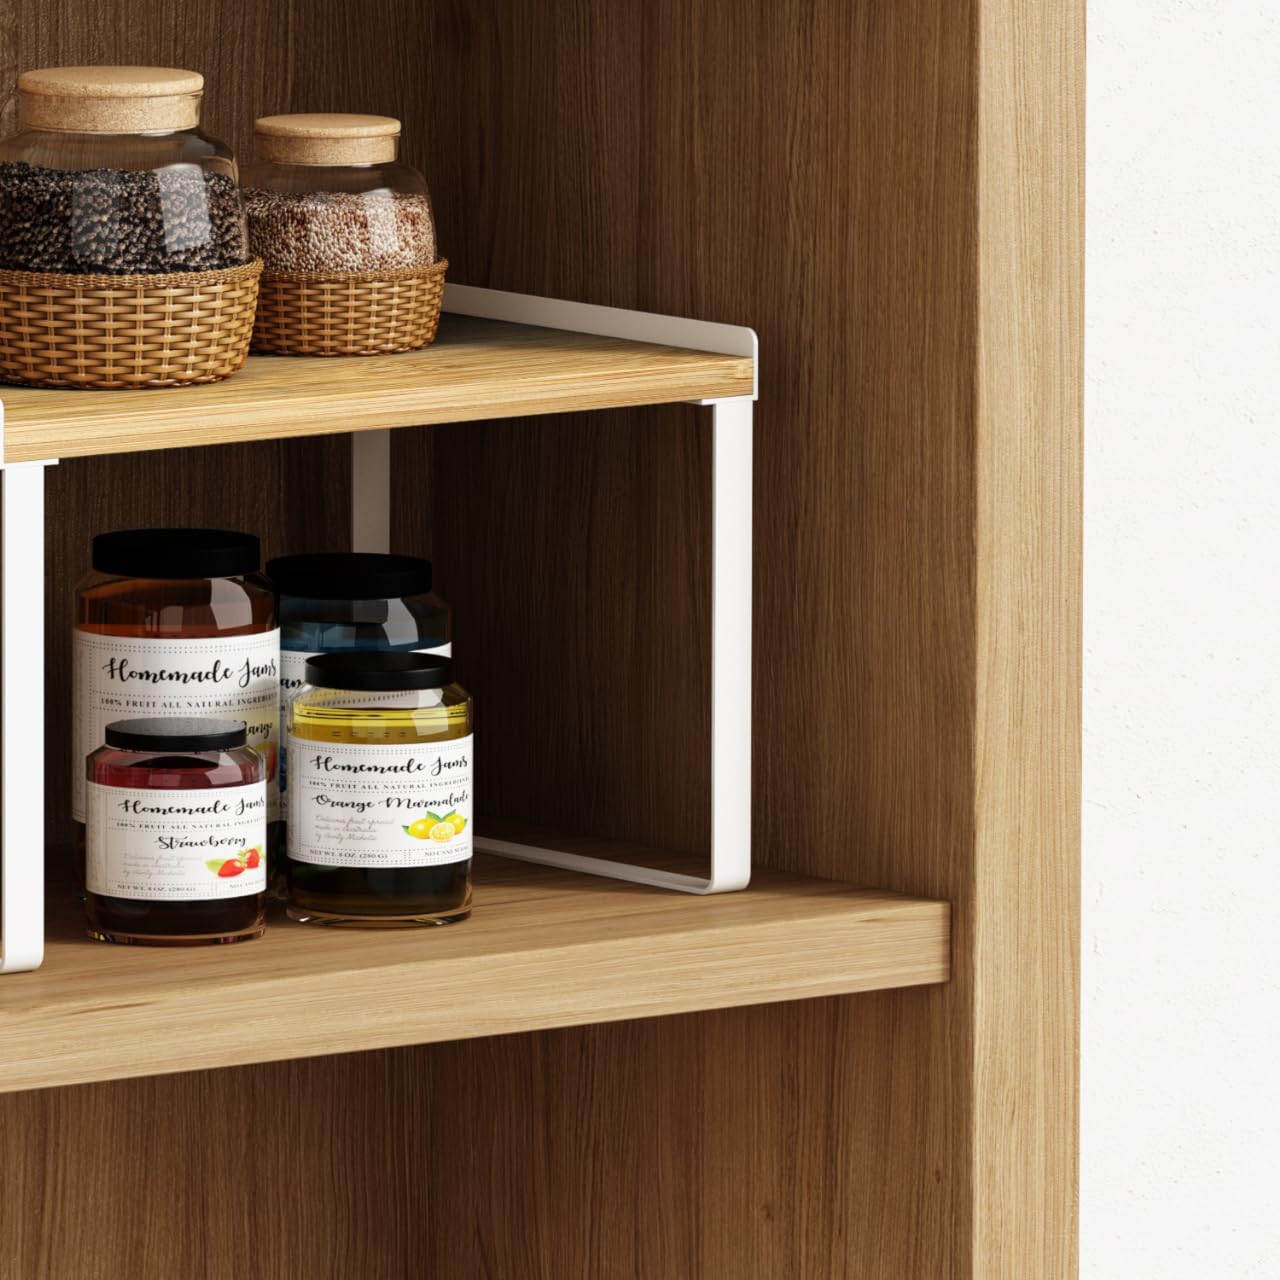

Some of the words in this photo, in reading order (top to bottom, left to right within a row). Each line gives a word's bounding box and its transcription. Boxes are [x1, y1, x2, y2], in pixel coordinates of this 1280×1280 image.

[102, 657, 233, 684] Homemade
[238, 657, 277, 688] Jams
[100, 697, 122, 707] 100%
[126, 699, 156, 709] FRUIT
[161, 700, 183, 709] ALL
[186, 699, 234, 709] NATURAL
[309, 755, 427, 775] Homemade
[429, 755, 469, 777] Jams
[329, 782, 358, 790] FRUIT
[361, 782, 381, 790] ALL
[383, 782, 427, 790] NATURAL
[117, 799, 231, 816] Homemade
[234, 796, 265, 816] Jams
[311, 794, 376, 813] Orange
[139, 822, 166, 830] FRUIT
[191, 822, 231, 830] NATURAL
